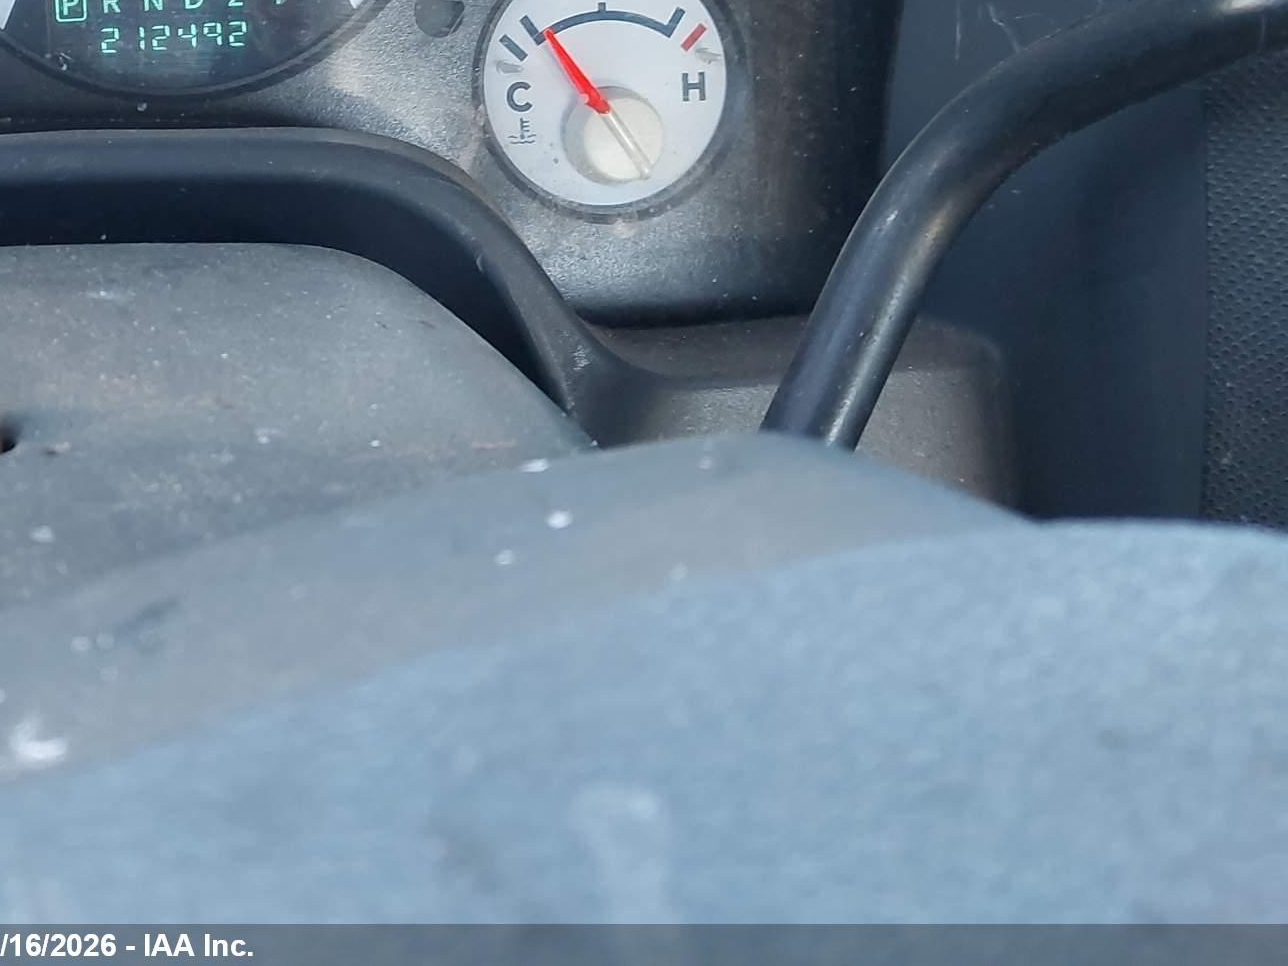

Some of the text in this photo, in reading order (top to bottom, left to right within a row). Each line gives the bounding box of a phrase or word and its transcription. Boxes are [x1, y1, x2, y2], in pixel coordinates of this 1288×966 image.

[101, 21, 247, 54] 212492
[506, 81, 533, 113] C
[681, 71, 707, 102] H
